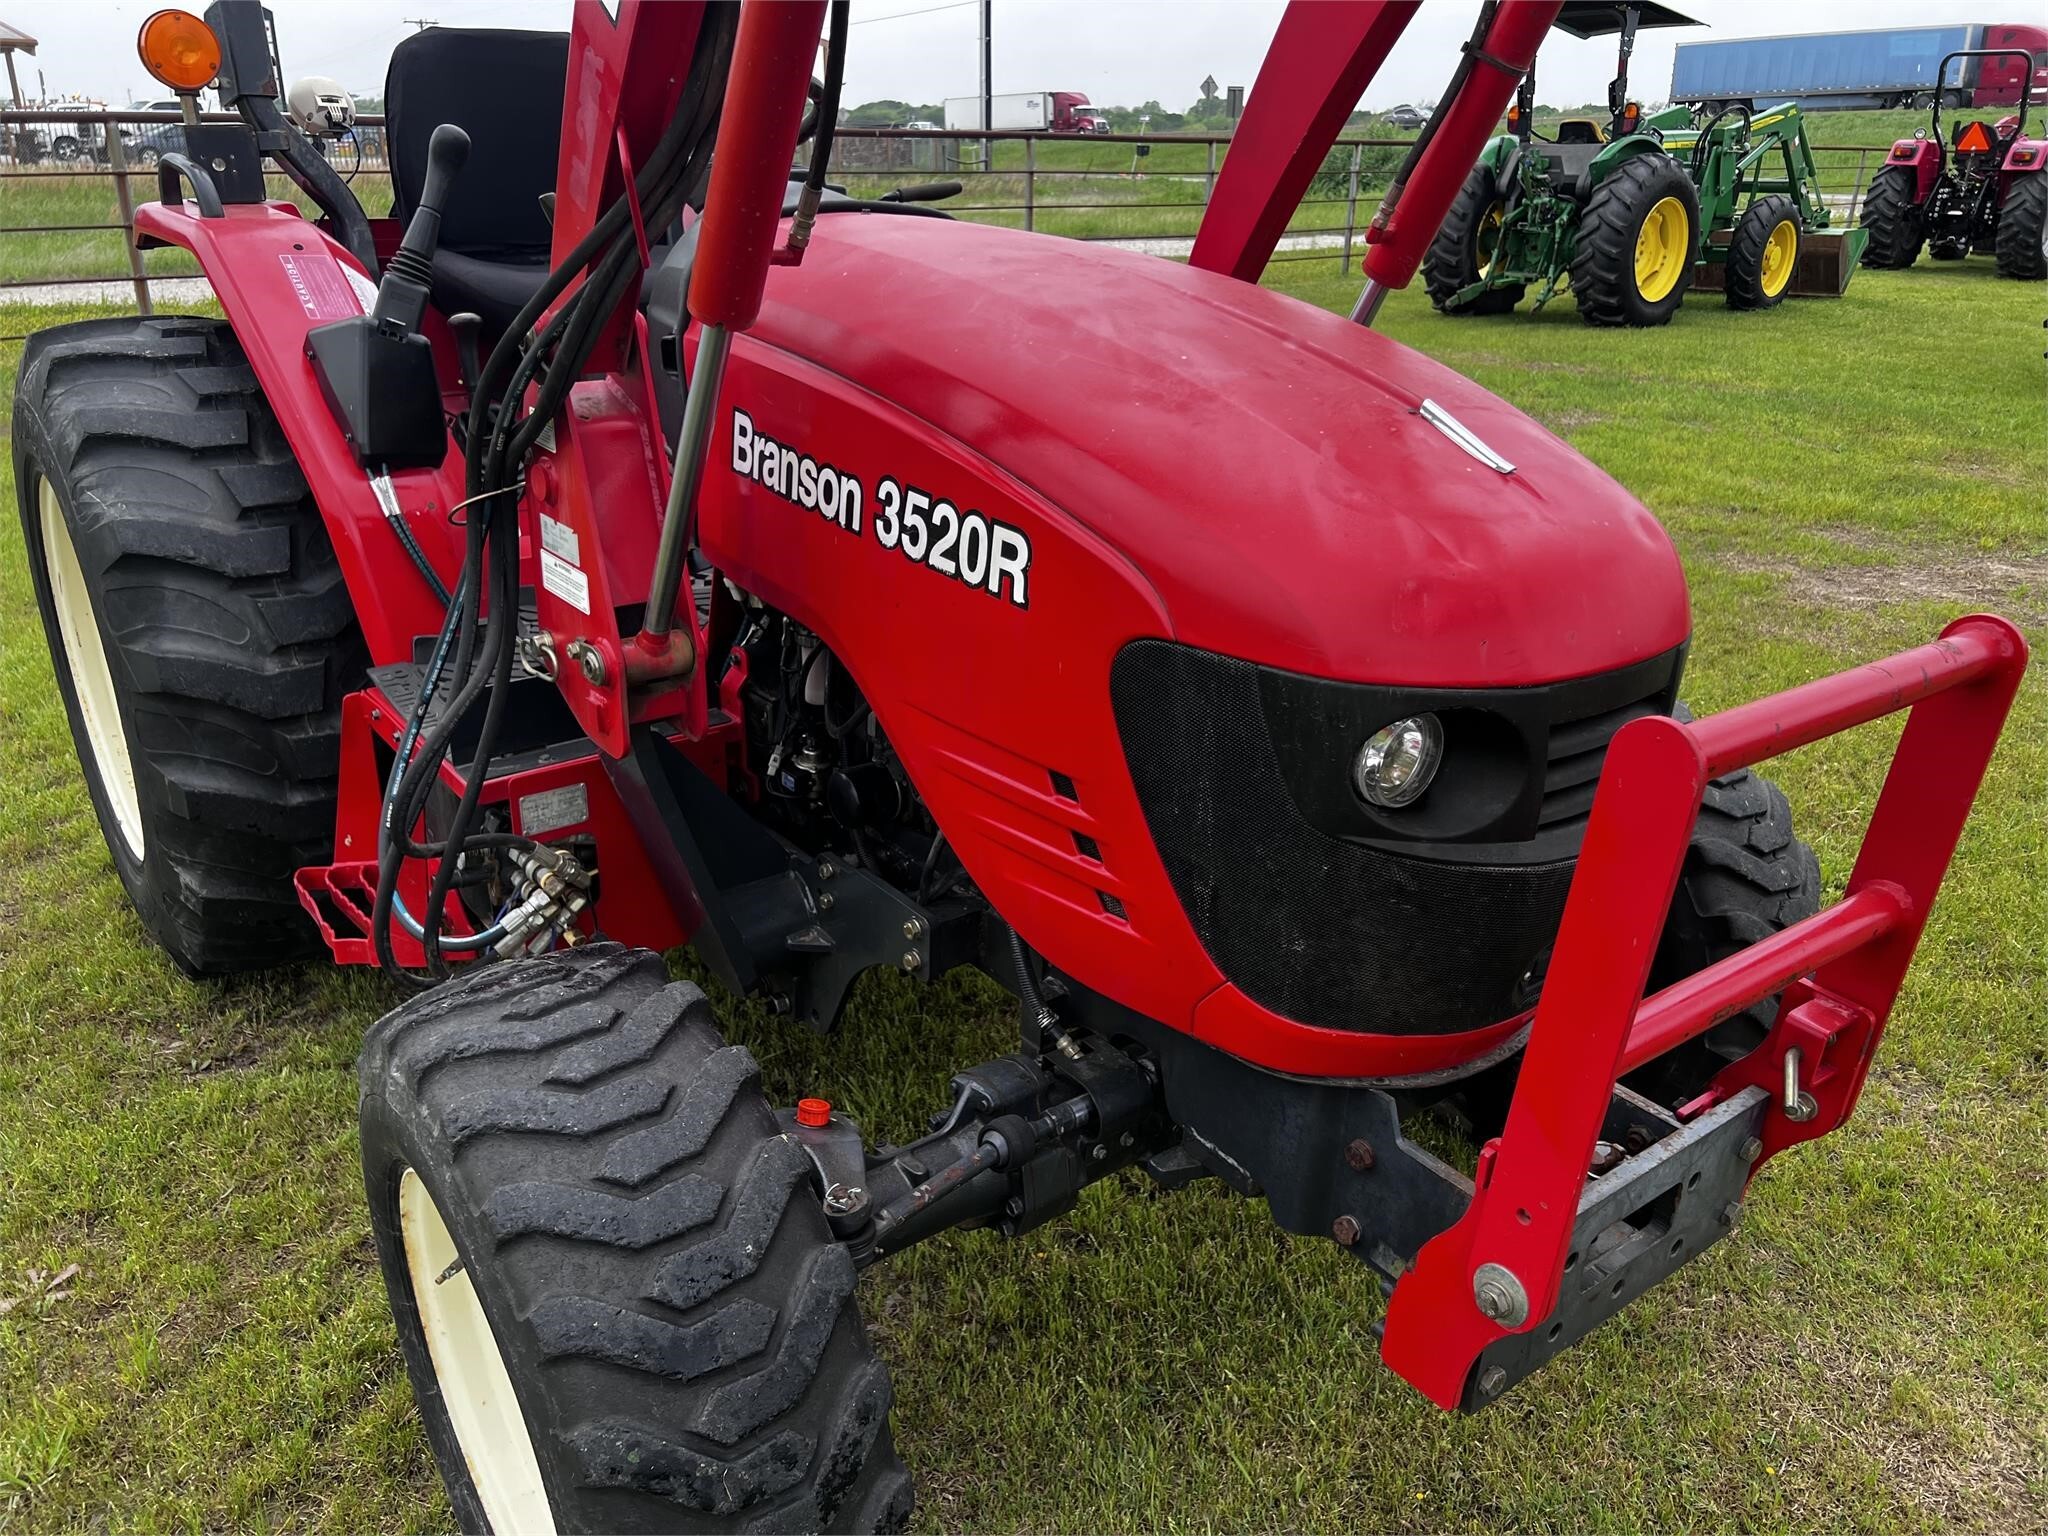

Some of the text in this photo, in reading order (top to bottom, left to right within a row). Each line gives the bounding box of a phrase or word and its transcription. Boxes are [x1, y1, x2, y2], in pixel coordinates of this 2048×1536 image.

[285, 263, 309, 301] CAUTION
[732, 409, 863, 533] Branson
[875, 477, 1030, 606] 3520R
